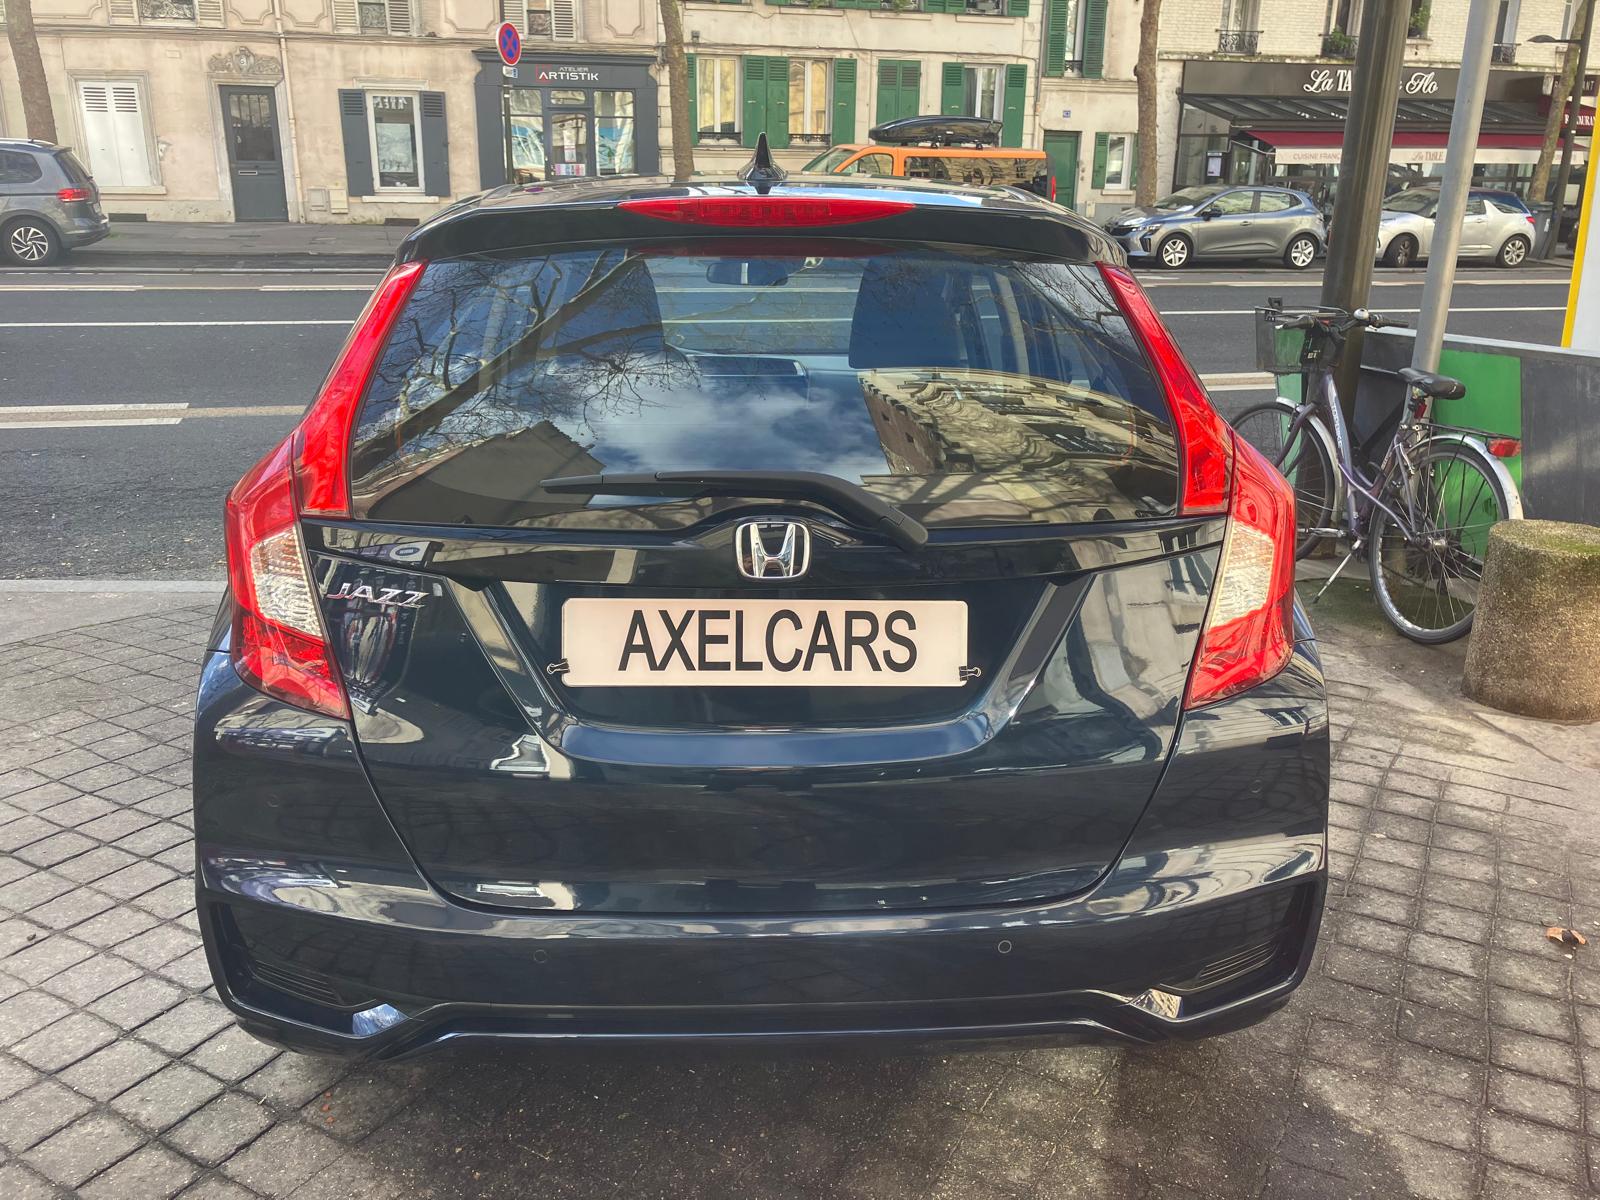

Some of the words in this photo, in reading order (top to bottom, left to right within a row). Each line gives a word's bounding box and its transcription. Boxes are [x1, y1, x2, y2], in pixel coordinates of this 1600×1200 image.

[539, 72, 599, 81] ARTISTIK
[1303, 70, 1334, 93] La
[326, 582, 430, 608] JAZZ
[618, 608, 918, 673] AXELCARS
